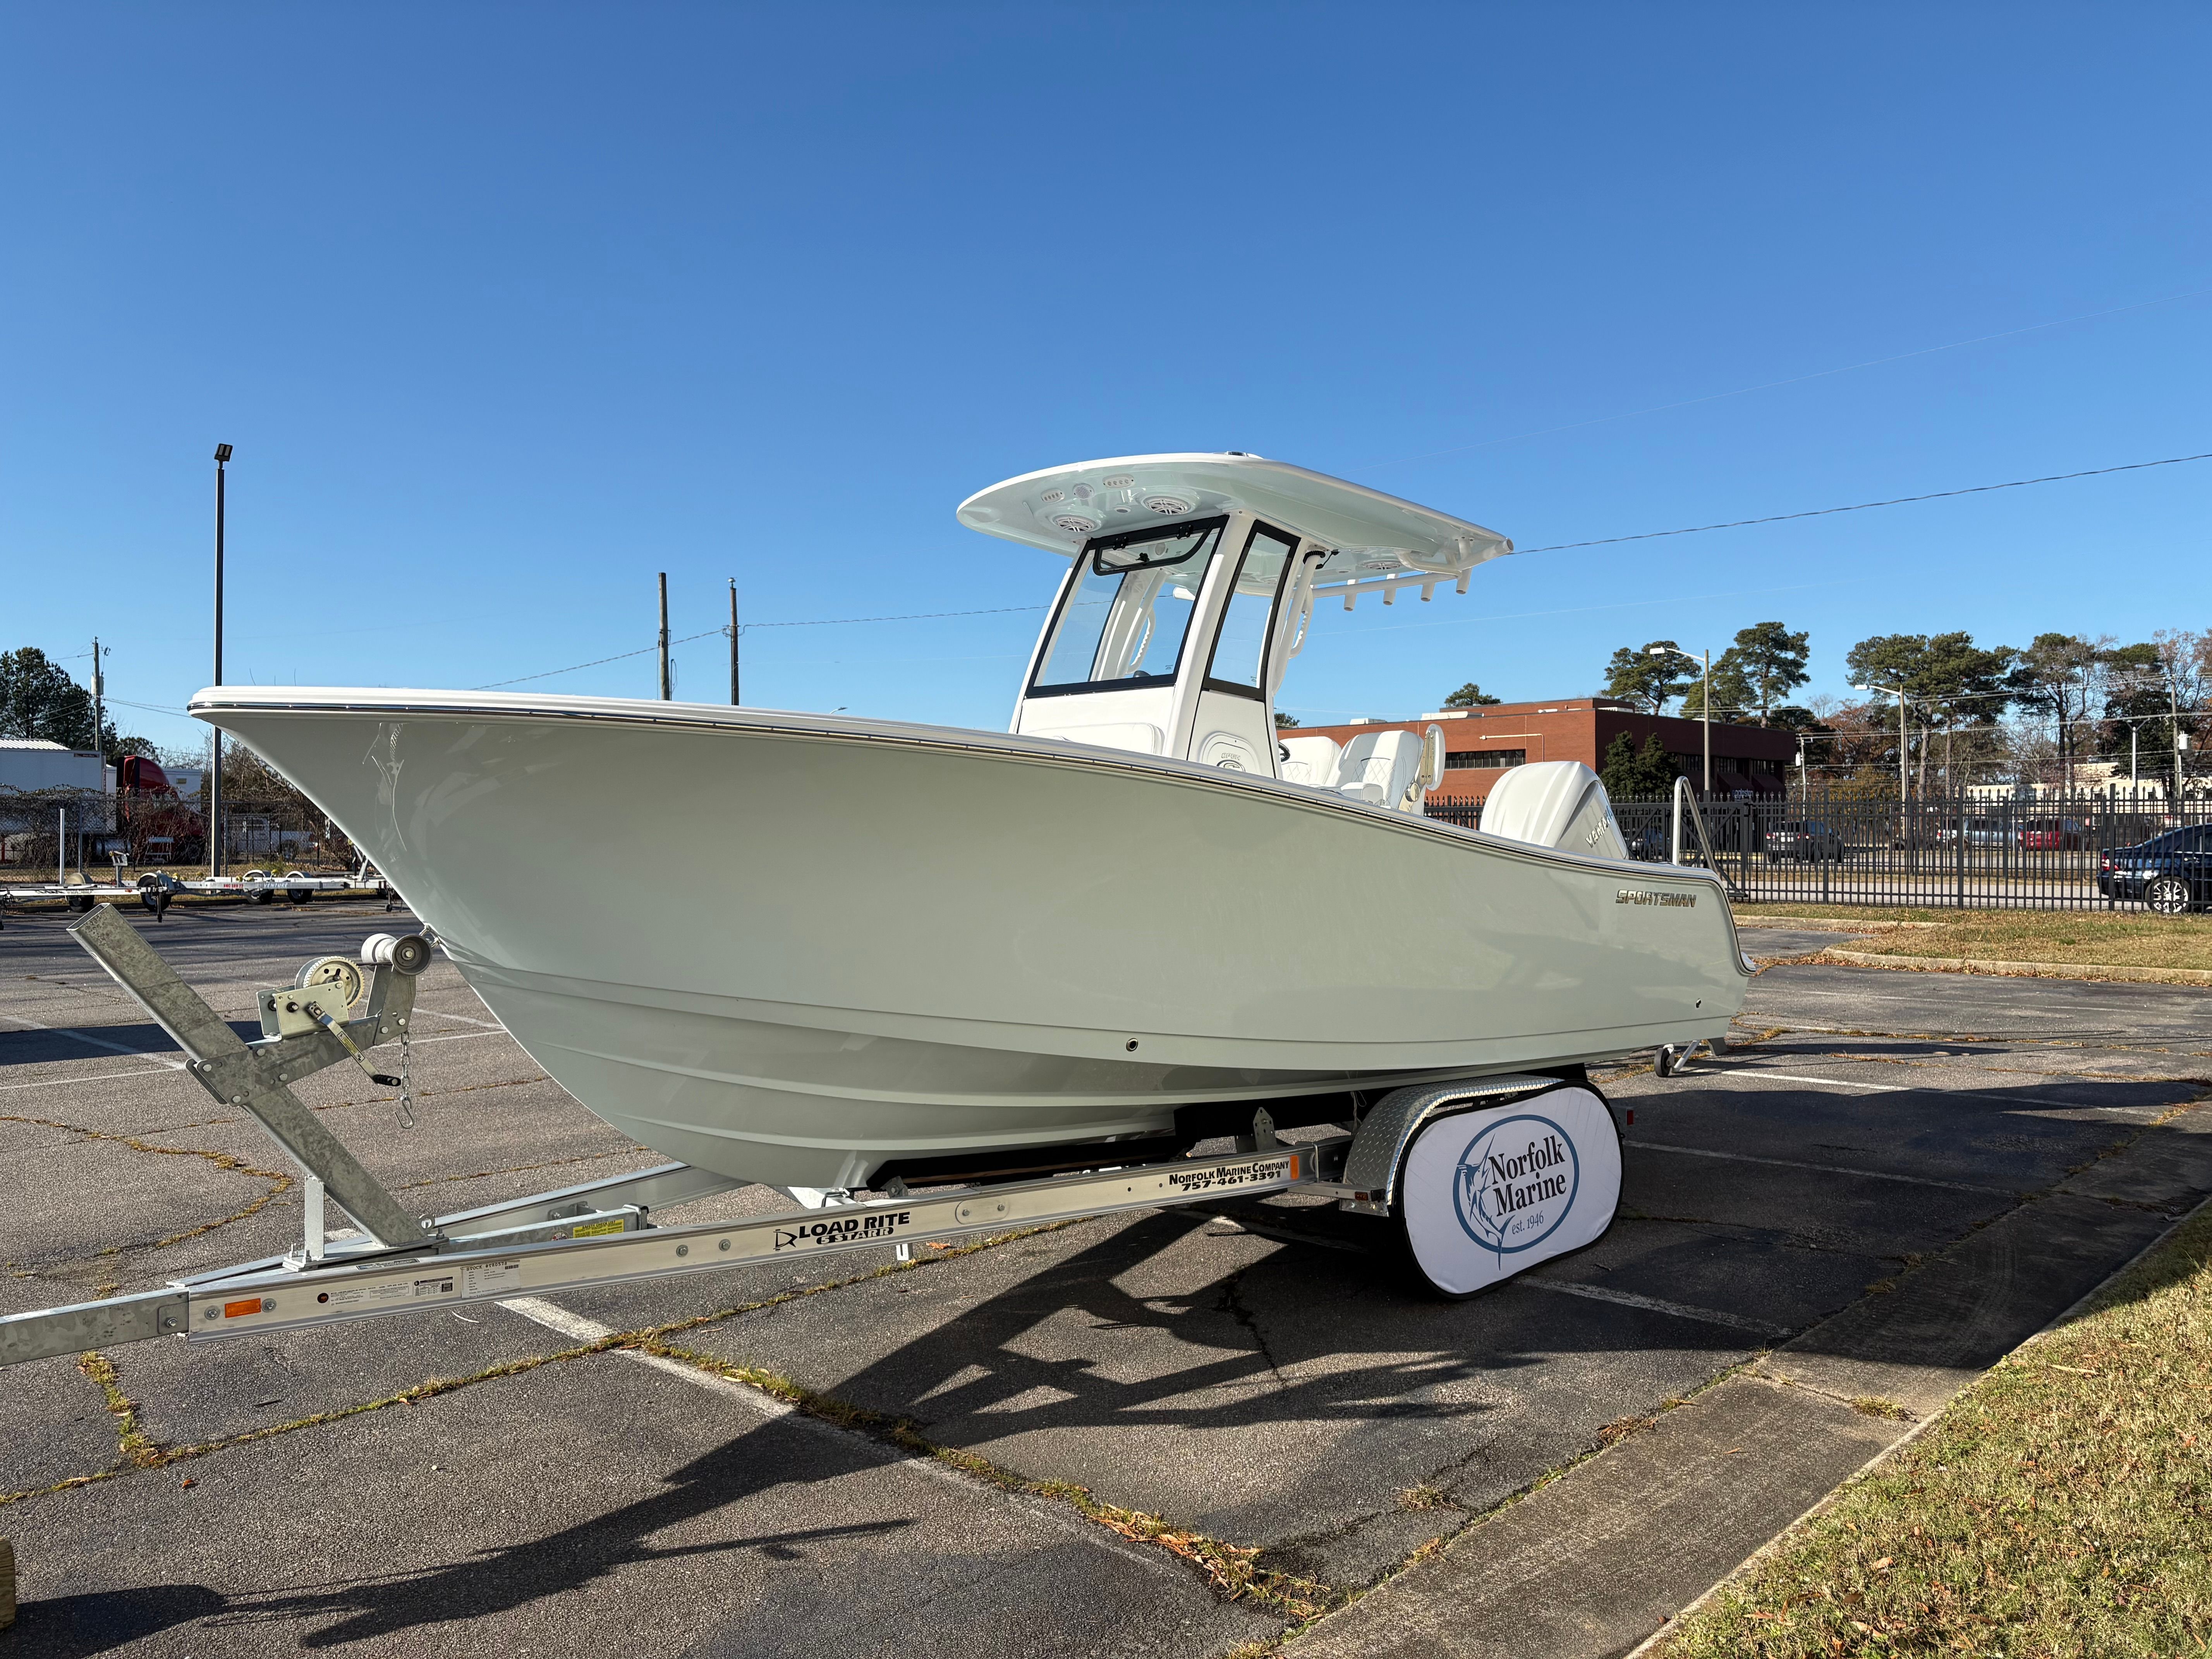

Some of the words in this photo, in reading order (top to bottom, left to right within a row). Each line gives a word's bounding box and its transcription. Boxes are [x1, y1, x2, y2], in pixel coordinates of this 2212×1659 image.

[1616, 890, 1697, 907] SPORTSMAN
[1488, 1135, 1565, 1185] Norfolk
[1182, 1170, 1281, 1191] 757-461-3391
[1493, 1172, 1566, 1217] Marine
[799, 1219, 859, 1238] LOAD
[864, 1211, 910, 1230] RITE
[1512, 1220, 1525, 1235] est.
[1527, 1210, 1544, 1229] 1946
[821, 1235, 830, 1244] 5
[835, 1227, 890, 1242] STARR
